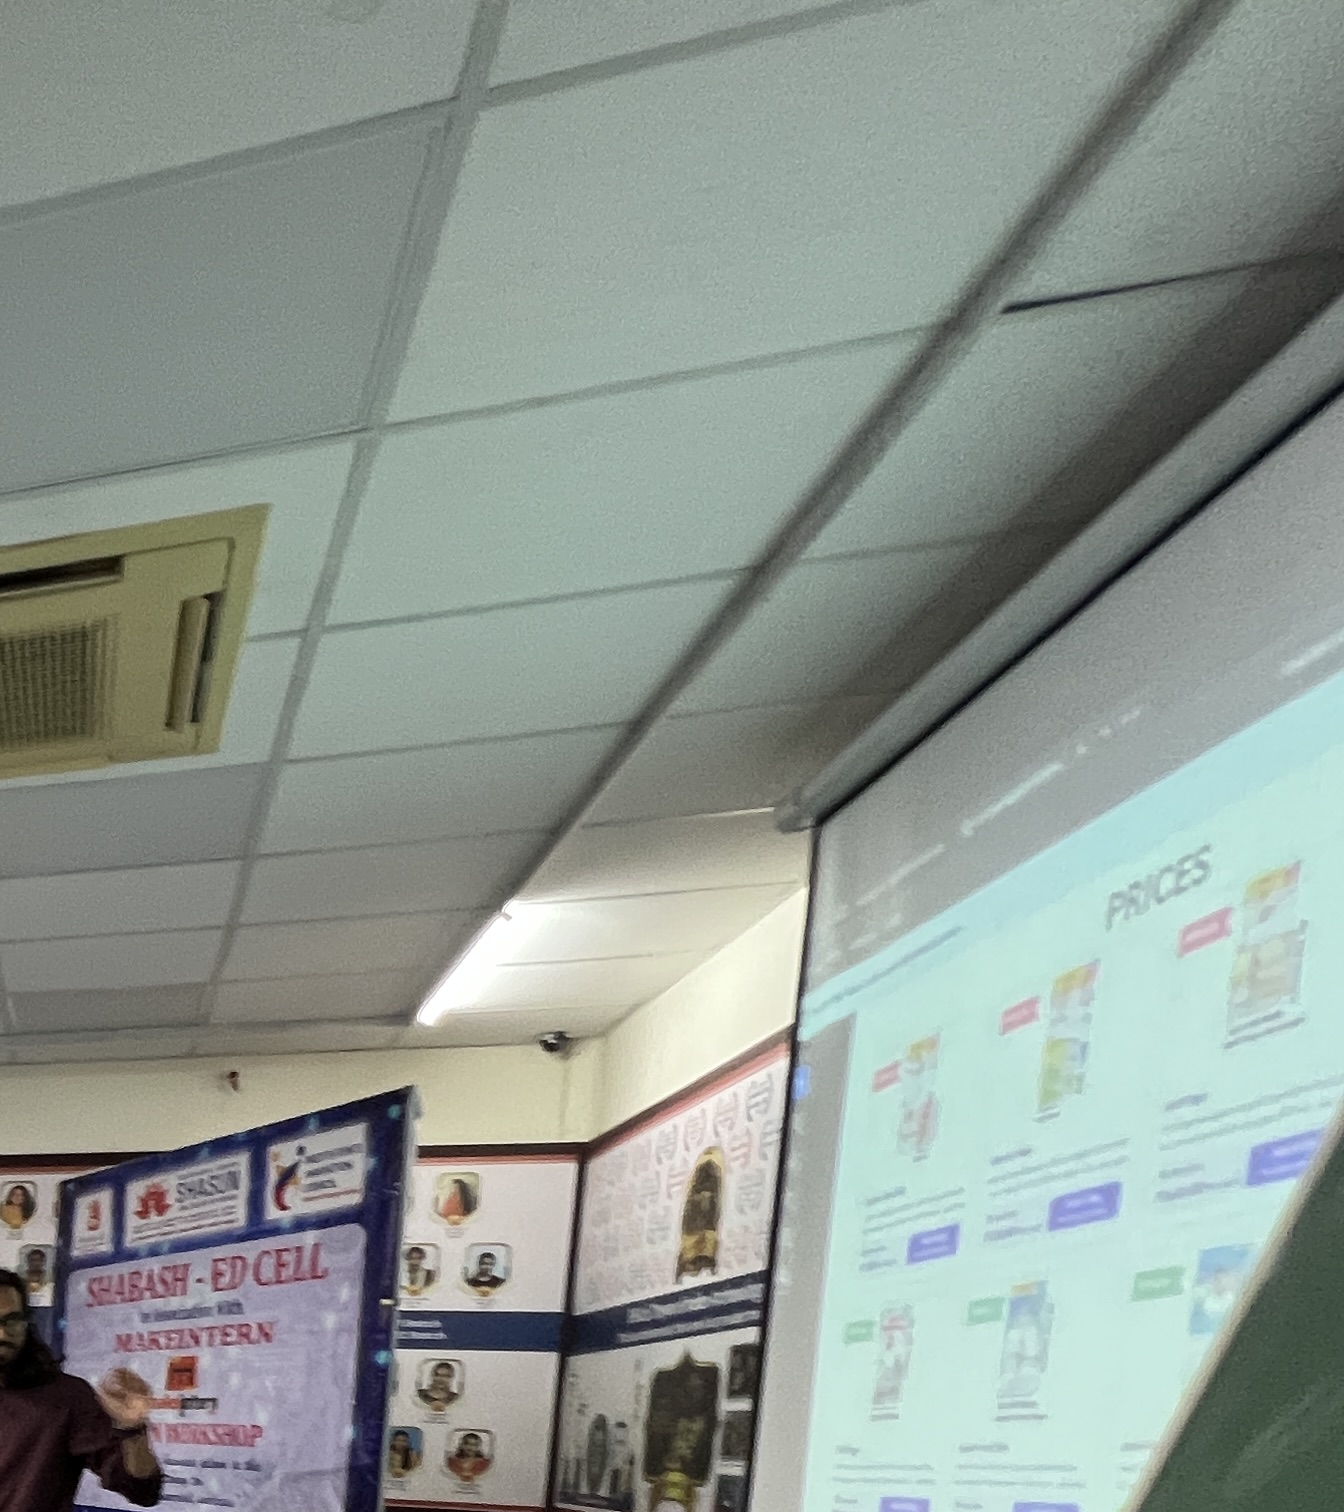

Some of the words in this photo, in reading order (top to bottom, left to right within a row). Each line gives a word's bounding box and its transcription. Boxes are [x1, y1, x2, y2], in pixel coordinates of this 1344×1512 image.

[1105, 843, 1212, 932] PRICES
[86, 1262, 191, 1308] SHABASH
[212, 1254, 248, 1292] ED
[253, 1242, 329, 1287] CELL
[114, 1320, 278, 1353] MAKEINTERN
